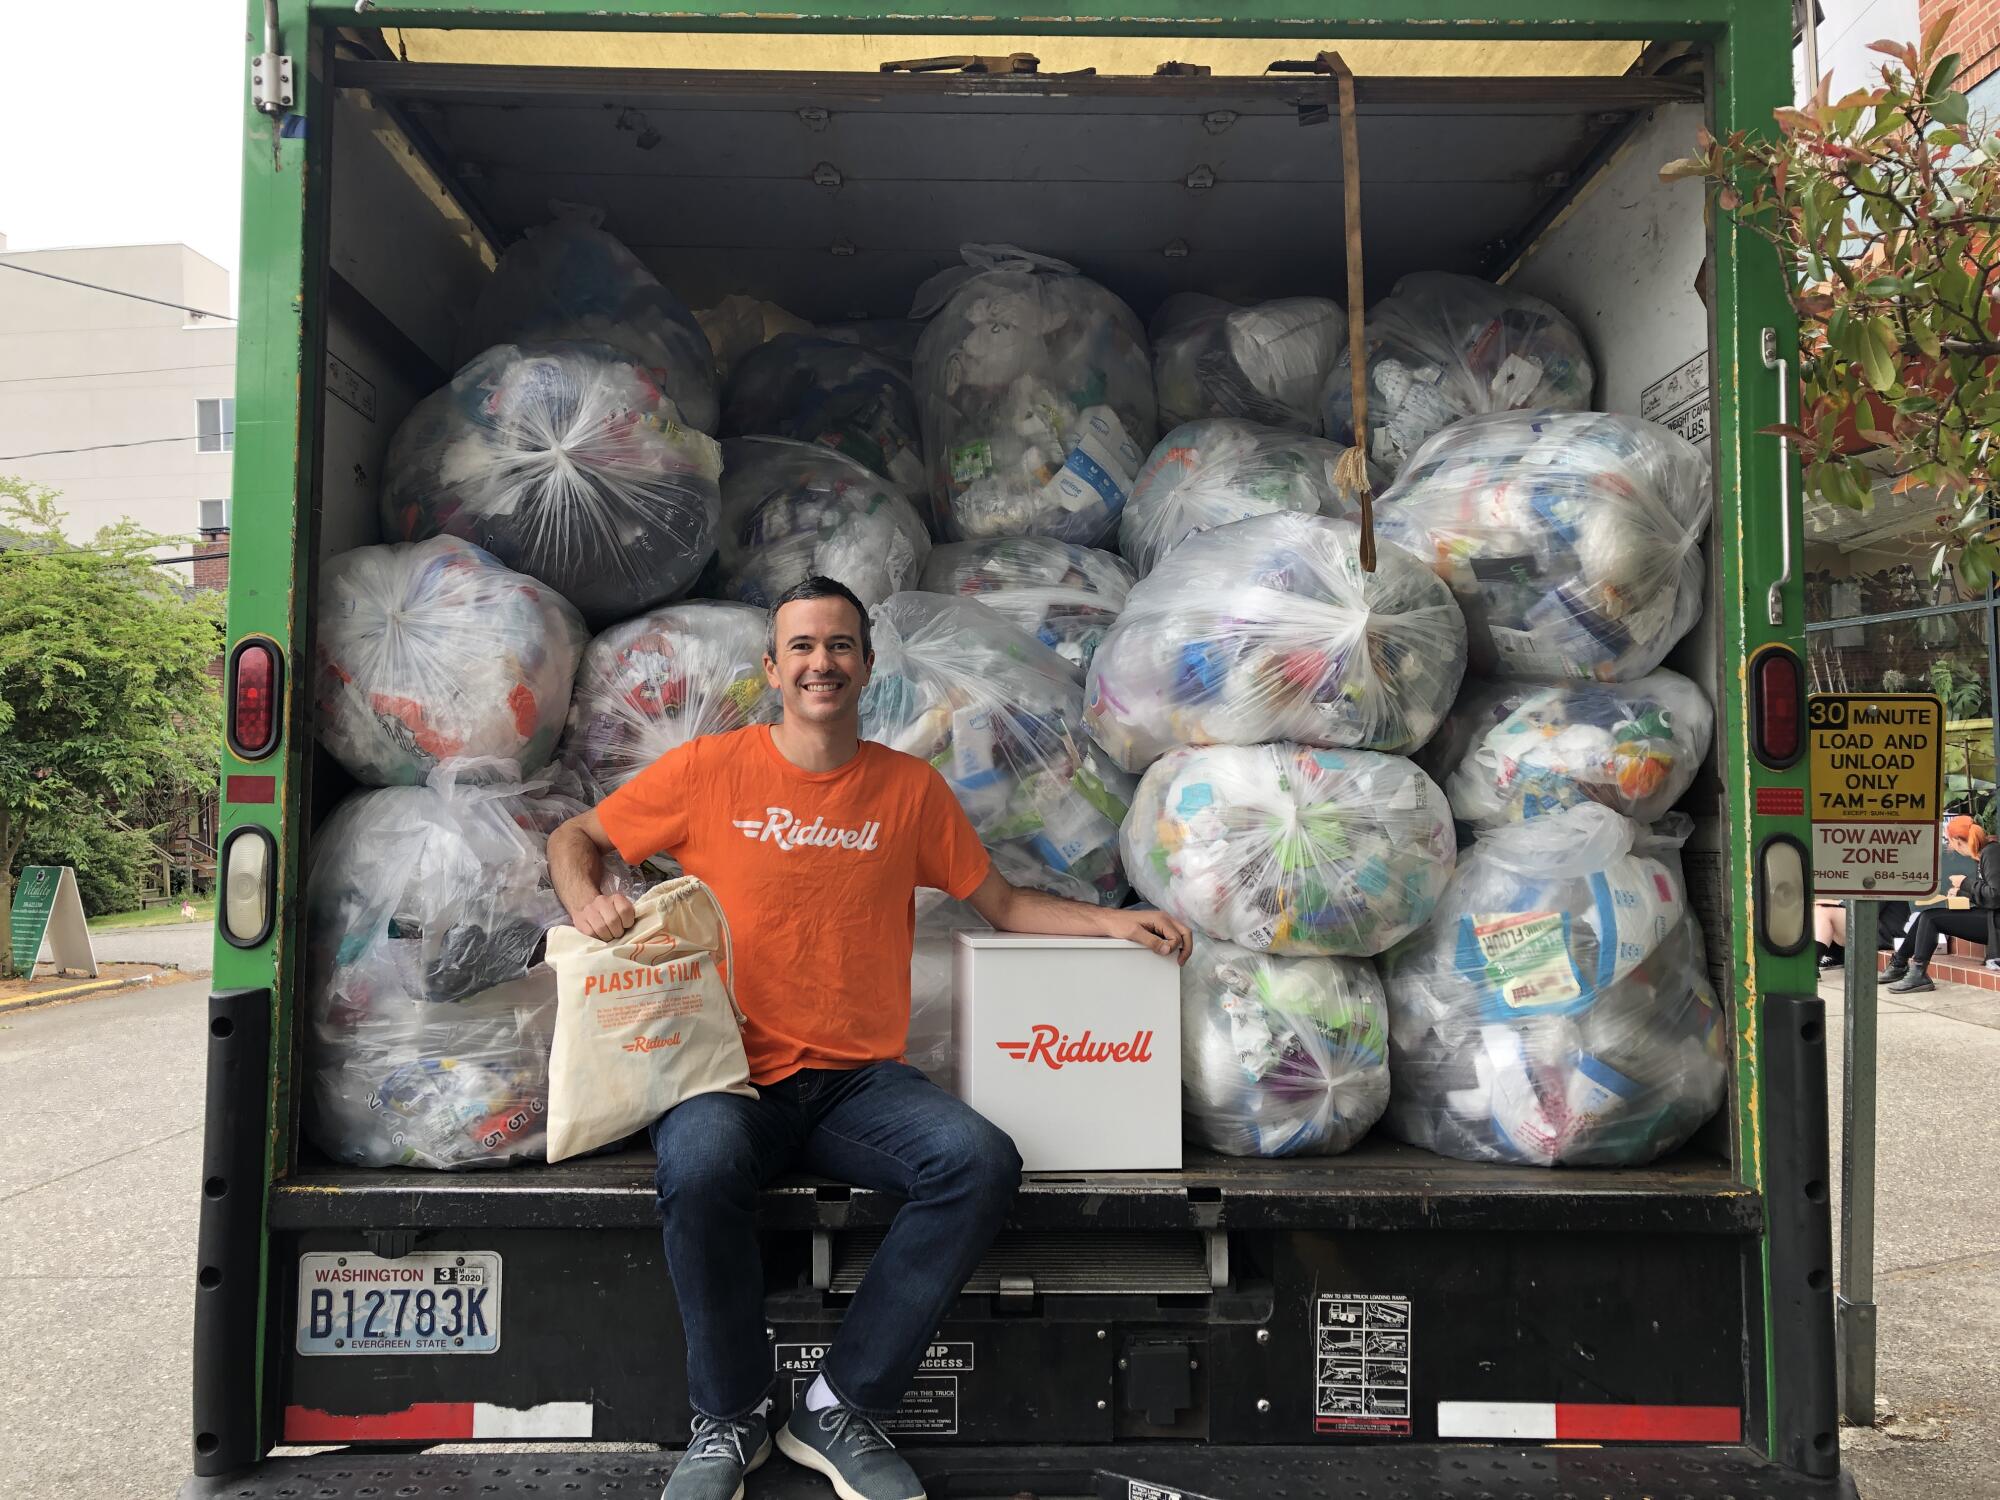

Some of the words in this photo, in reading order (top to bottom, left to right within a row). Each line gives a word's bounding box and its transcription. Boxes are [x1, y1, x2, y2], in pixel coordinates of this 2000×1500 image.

[1810, 702, 1845, 724] 30
[1853, 709, 1931, 725] MINUTE
[1819, 733, 1873, 750] LOAD
[1884, 734, 1927, 750] AND
[1830, 754, 1915, 770] UNLOAD
[1845, 773, 1899, 790] ONLY
[1819, 792, 1925, 809] 7AM-6PM
[760, 806, 880, 851] Ridwell
[1820, 828, 1866, 844] TOW
[1868, 829, 1922, 845] AWAY
[1842, 848, 1899, 864] ZONE
[1813, 870, 1849, 879] PHONE
[1874, 871, 1930, 880] 684-5444
[584, 967, 664, 996] PLASTIC
[668, 960, 702, 982] FILM
[634, 1032, 682, 1053] Ridwell
[1028, 1024, 1153, 1070] Ridwell
[315, 1269, 424, 1283] WASHINGTON
[439, 1268, 451, 1281] 3
[459, 1274, 481, 1282] 2020
[310, 1288, 489, 1339] B12783K
[351, 1340, 411, 1349] EVERGREEN
[416, 1340, 447, 1348] STATE
